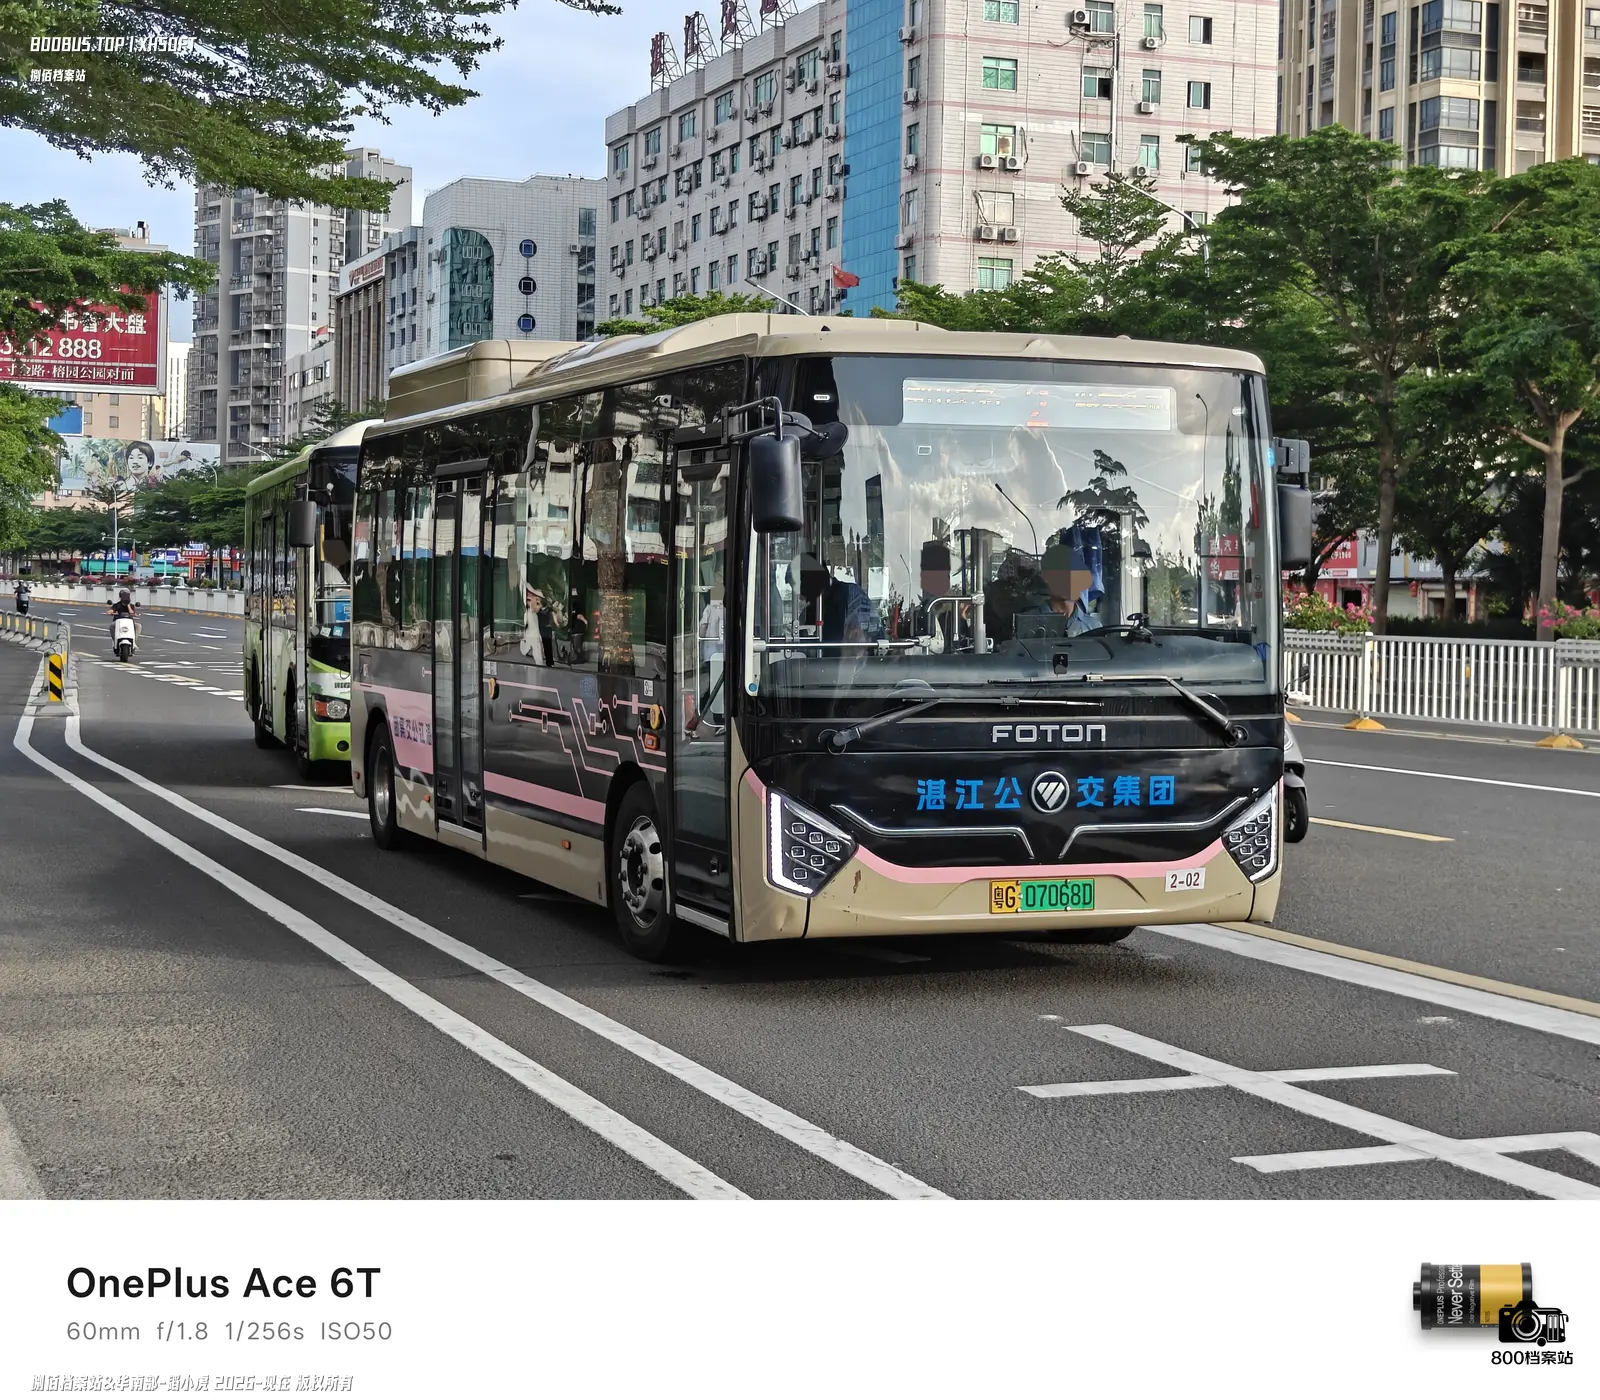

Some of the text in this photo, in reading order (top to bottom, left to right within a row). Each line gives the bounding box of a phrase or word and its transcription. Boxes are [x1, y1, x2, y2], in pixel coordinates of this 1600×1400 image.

[42, 309, 147, 335] 书香大盘
[58, 337, 102, 359] 888
[992, 724, 1106, 743] FOTON
[916, 775, 1175, 810] 湛江公 交集团
[1169, 871, 1201, 889] 2-02
